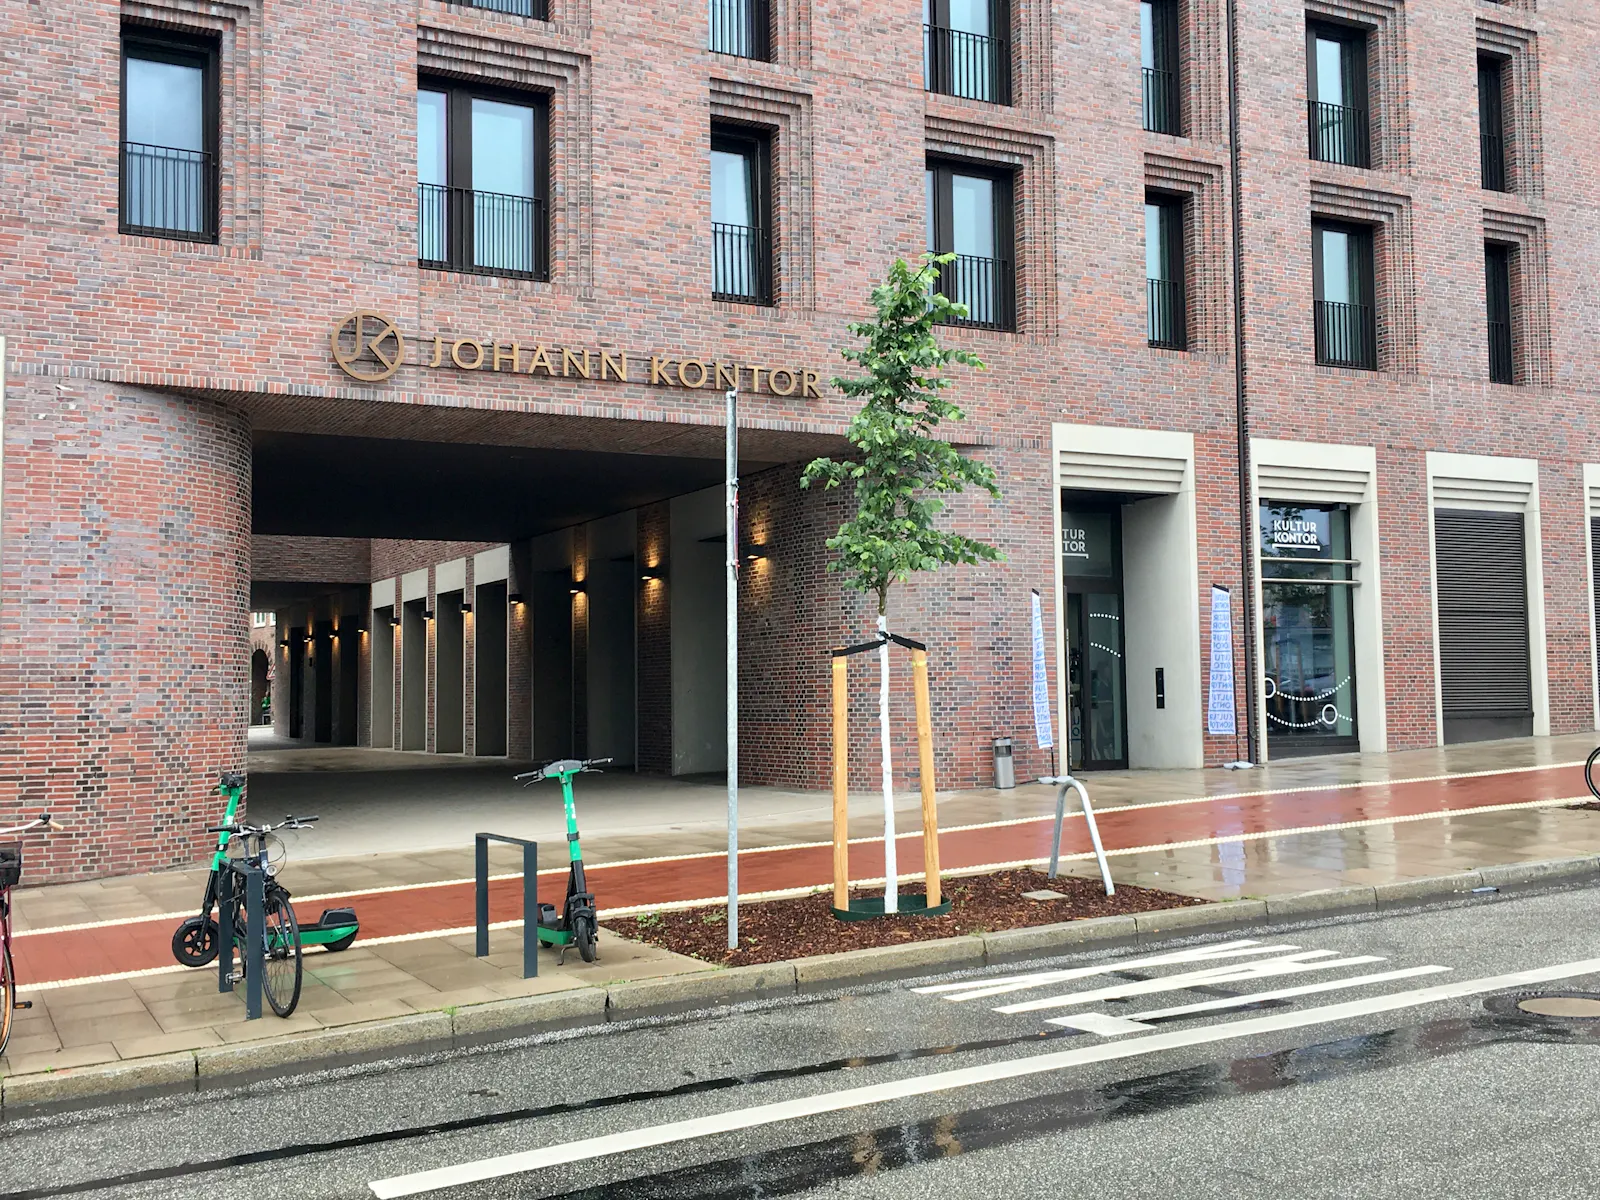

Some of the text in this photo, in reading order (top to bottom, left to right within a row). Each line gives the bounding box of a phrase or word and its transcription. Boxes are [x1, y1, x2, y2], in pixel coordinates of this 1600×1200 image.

[430, 337, 823, 398] JOHANN KONTOR
[1273, 520, 1317, 532] KULTUR
[1274, 531, 1318, 544] KONTOR
[1062, 540, 1086, 552] TOR
